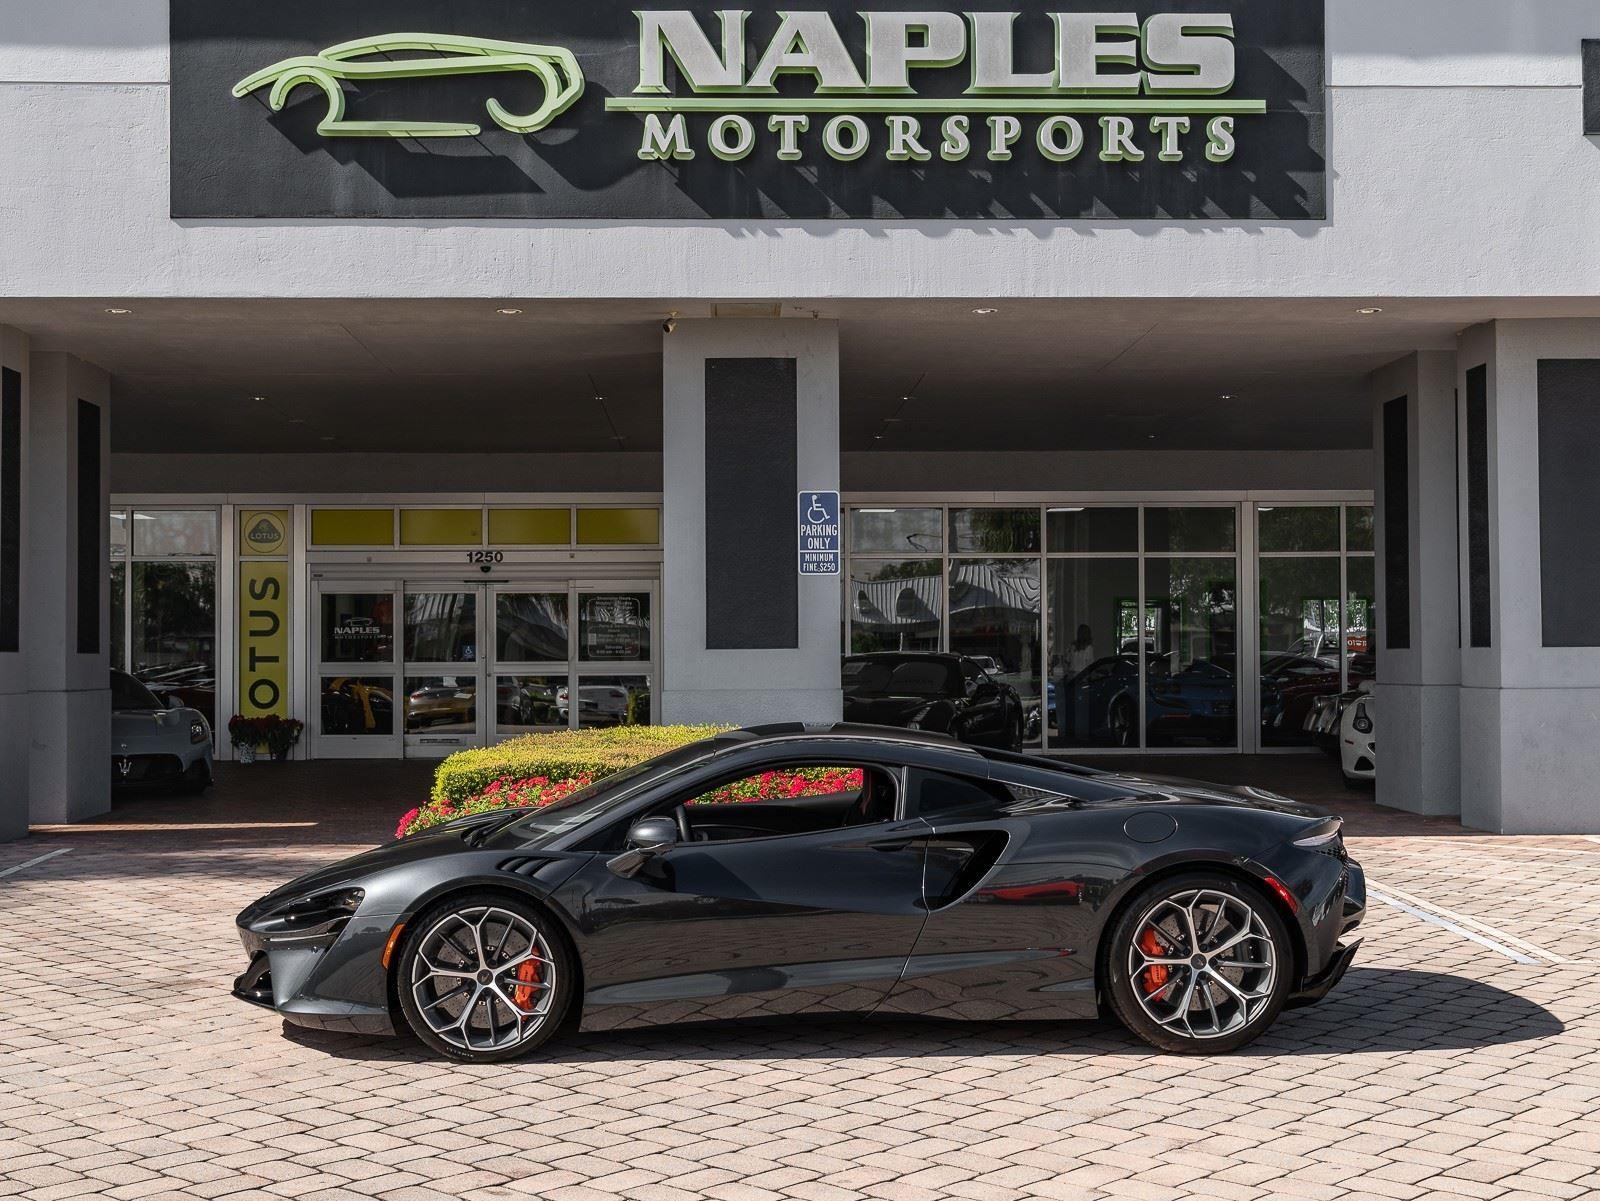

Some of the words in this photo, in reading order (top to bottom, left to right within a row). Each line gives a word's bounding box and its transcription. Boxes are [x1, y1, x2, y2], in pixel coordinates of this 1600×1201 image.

[632, 9, 1236, 95] NAPLES
[637, 113, 1237, 162] MOTORSPORTS
[801, 525, 837, 536] PARKING
[250, 532, 280, 541] LOTUS
[808, 538, 830, 549] ONLY
[466, 551, 504, 563] 1250
[803, 563, 817, 571] FINE
[820, 563, 835, 572] $250
[334, 626, 381, 634] NAPLES
[249, 576, 281, 710] OTUS
